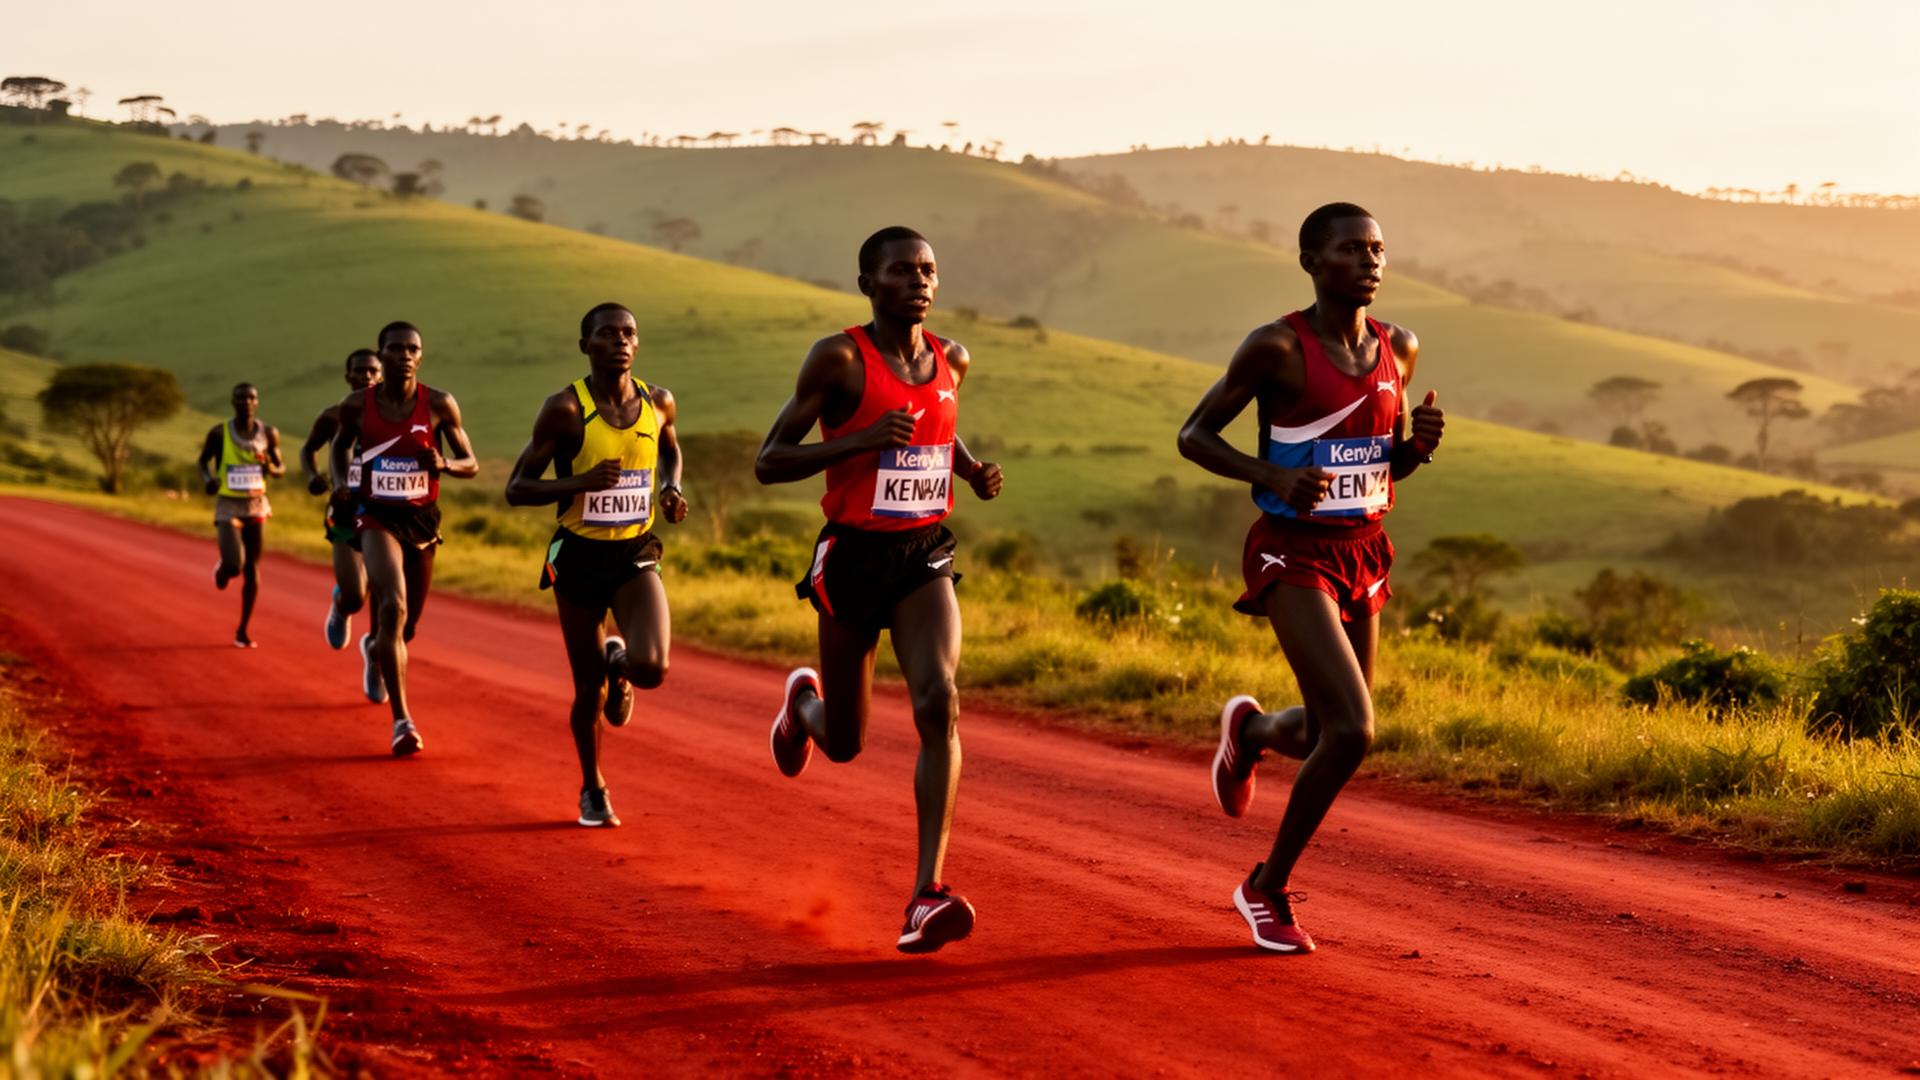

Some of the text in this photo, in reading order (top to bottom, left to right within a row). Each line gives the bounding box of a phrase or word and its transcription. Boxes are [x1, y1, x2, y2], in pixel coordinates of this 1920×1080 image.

[895, 448, 945, 471] Kenya
[1330, 440, 1382, 464] Kenya
[588, 495, 647, 514] KENIYA
